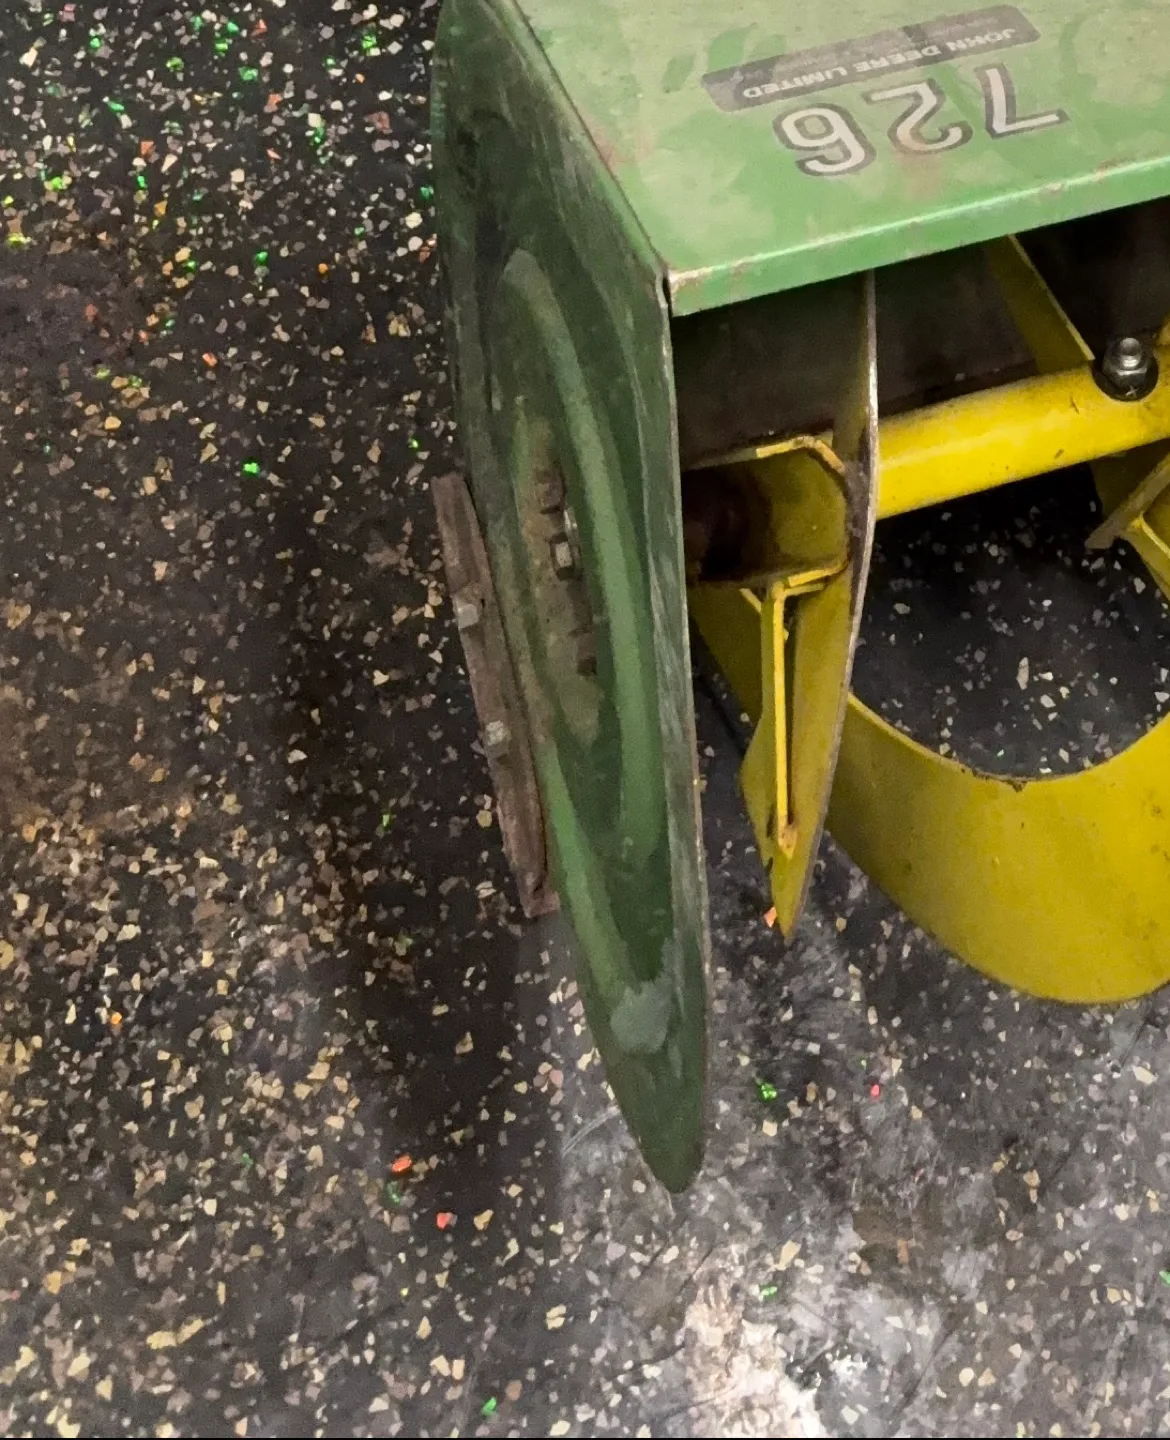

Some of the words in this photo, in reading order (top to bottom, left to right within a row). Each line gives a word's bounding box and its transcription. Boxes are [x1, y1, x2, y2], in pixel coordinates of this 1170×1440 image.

[945, 28, 1016, 52] JOHN
[852, 44, 942, 73] DEERE
[742, 66, 848, 98] LIMITED
[773, 62, 1071, 176] 726
